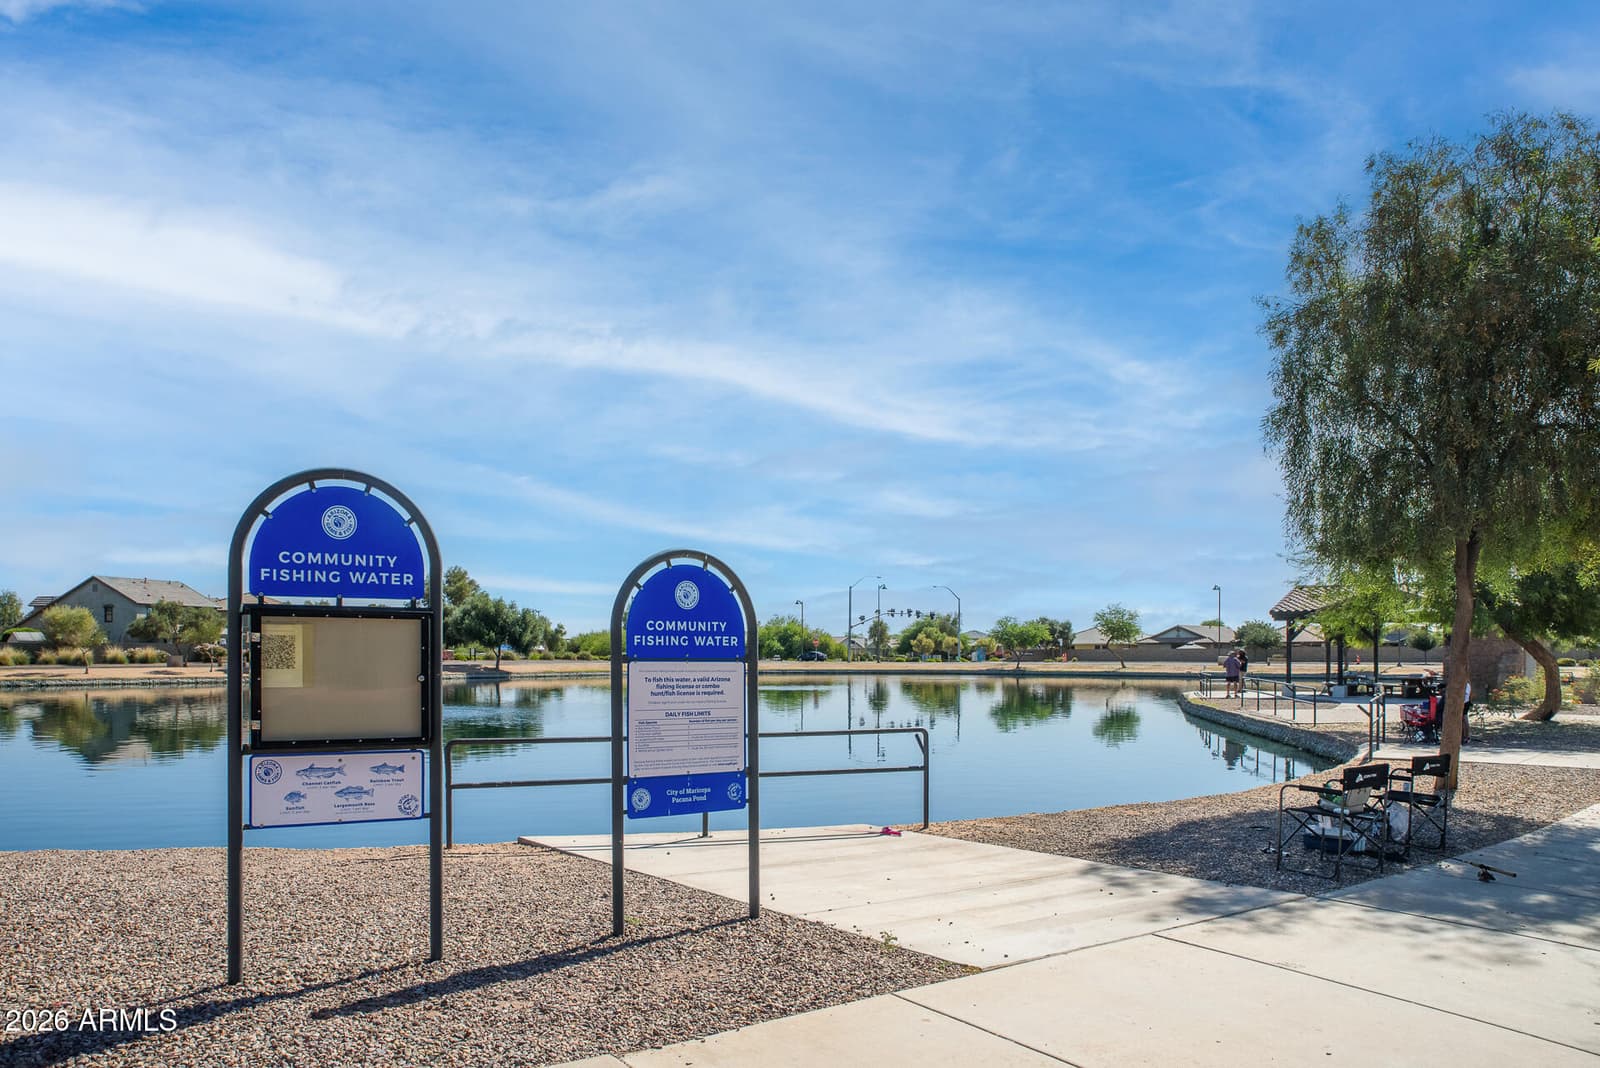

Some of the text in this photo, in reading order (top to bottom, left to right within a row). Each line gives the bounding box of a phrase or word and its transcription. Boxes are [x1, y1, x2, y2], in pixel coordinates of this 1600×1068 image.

[278, 551, 398, 568] COMMUNITY
[260, 568, 414, 586] FISHING WATER
[646, 620, 727, 632] COMMUNITY
[633, 635, 738, 647] FISHING WATER
[666, 788, 679, 796] City
